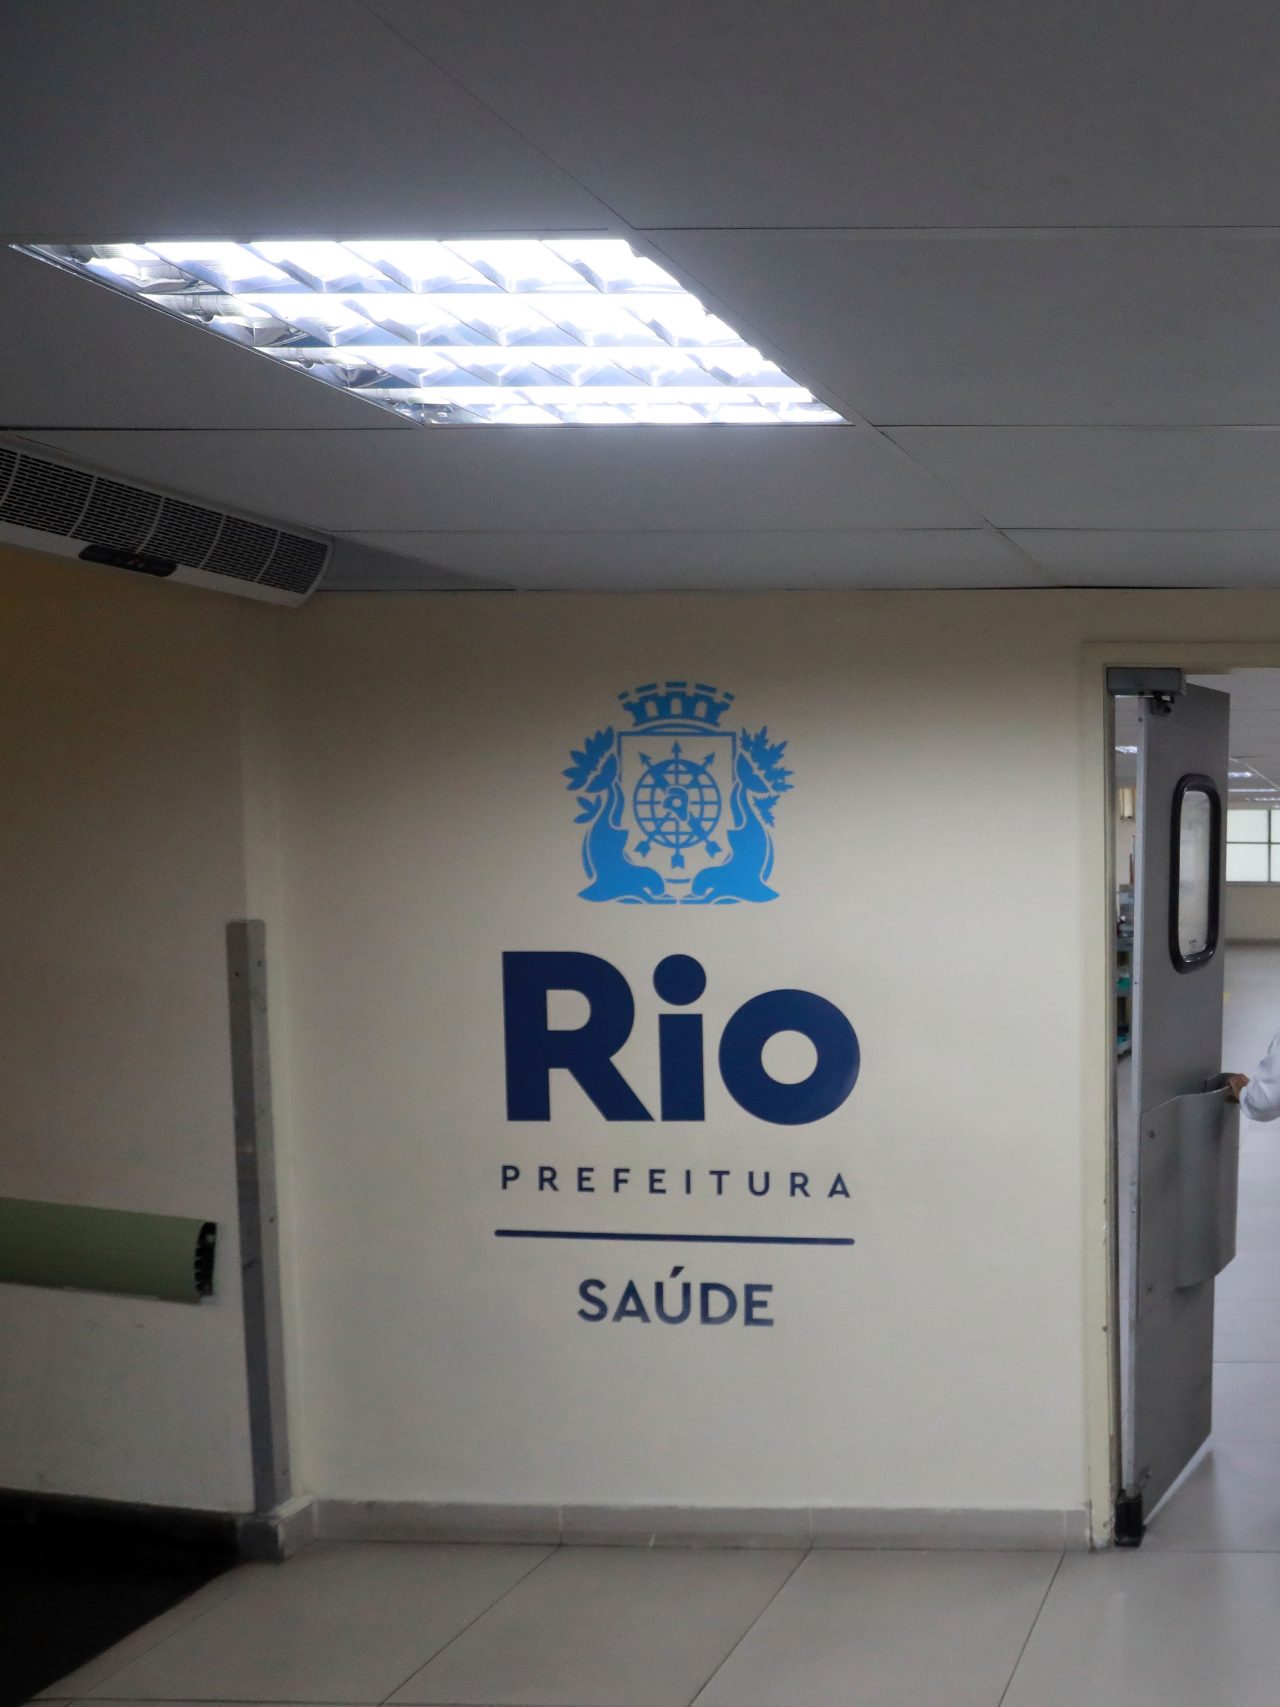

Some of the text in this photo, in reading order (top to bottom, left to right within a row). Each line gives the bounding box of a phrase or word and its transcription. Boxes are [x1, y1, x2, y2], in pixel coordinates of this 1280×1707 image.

[502, 950, 861, 1126] Rio
[501, 1165, 850, 1200] PREFEITURA
[578, 1266, 774, 1328] SAÚDE
